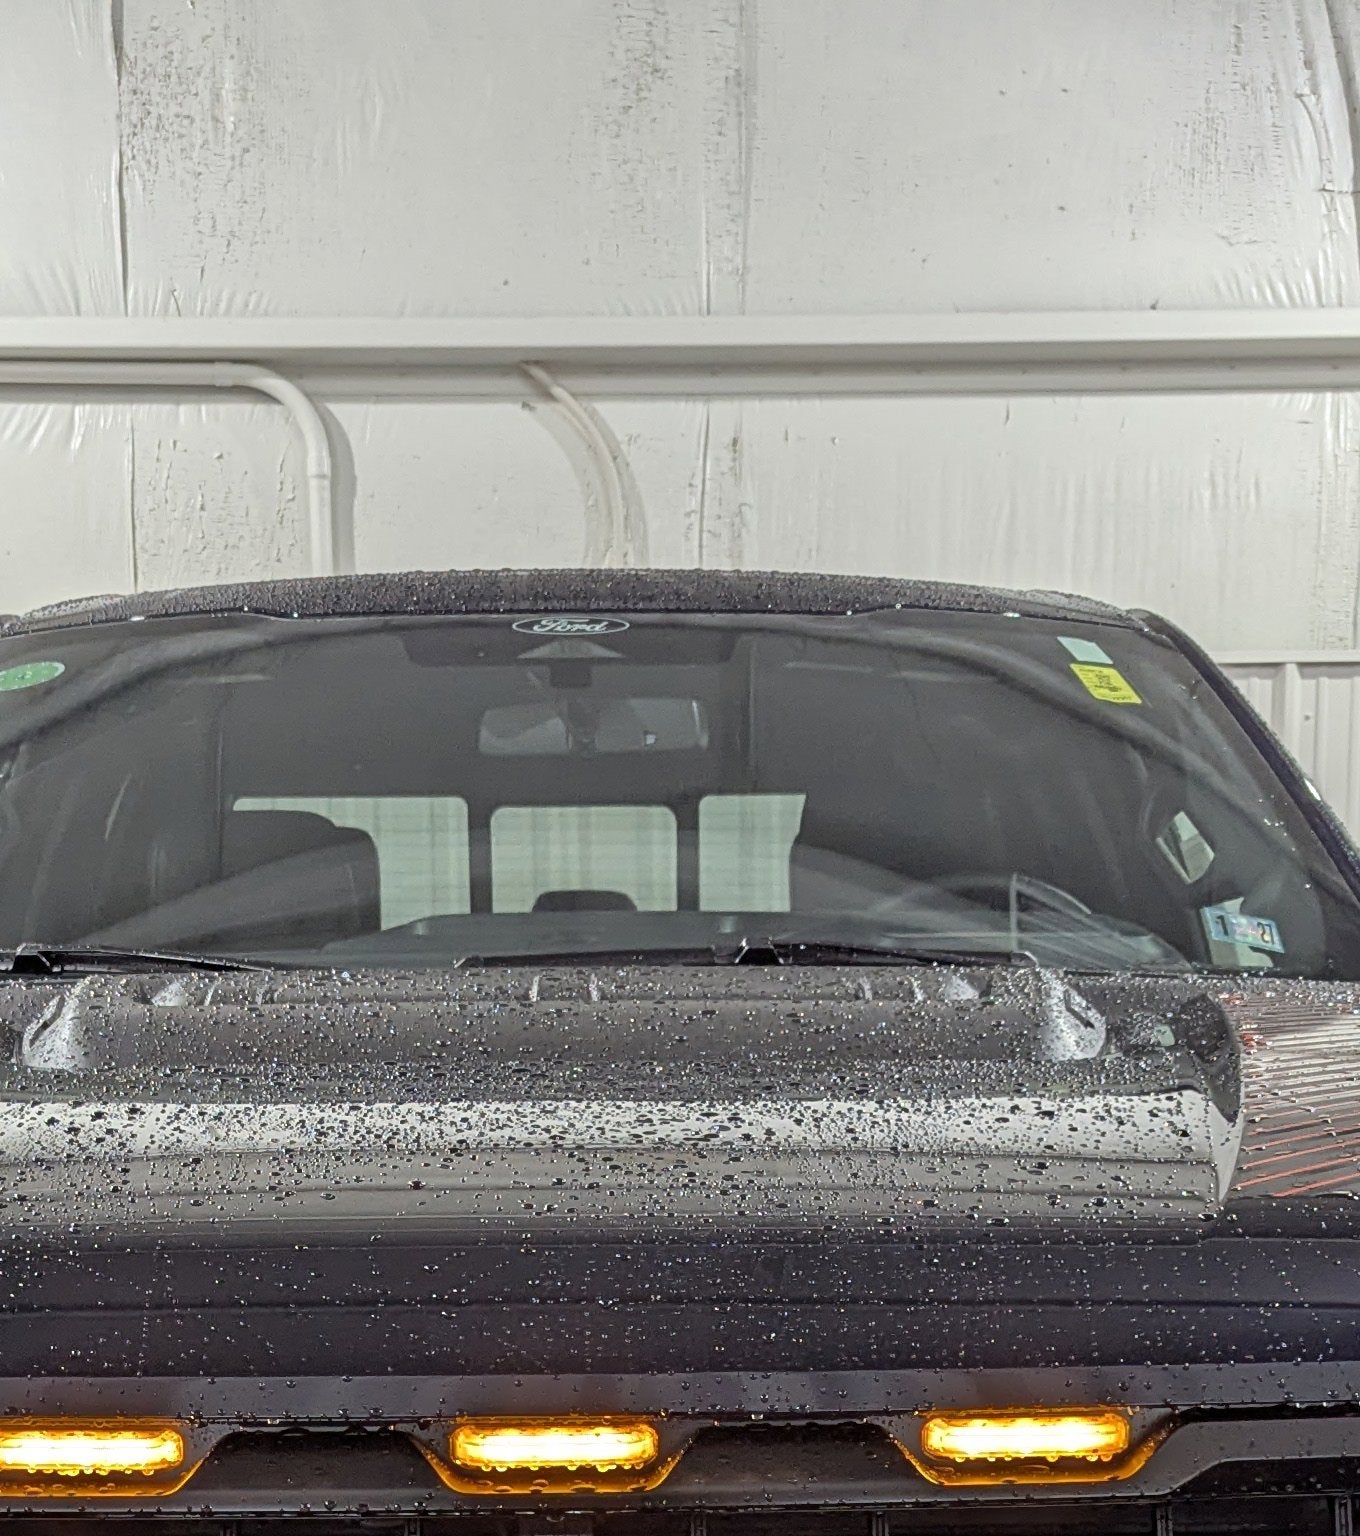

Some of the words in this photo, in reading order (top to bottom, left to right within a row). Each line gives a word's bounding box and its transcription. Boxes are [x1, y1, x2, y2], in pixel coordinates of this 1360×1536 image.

[532, 618, 609, 632] Ford
[1216, 914, 1229, 937] 1
[1256, 921, 1275, 945] 27
